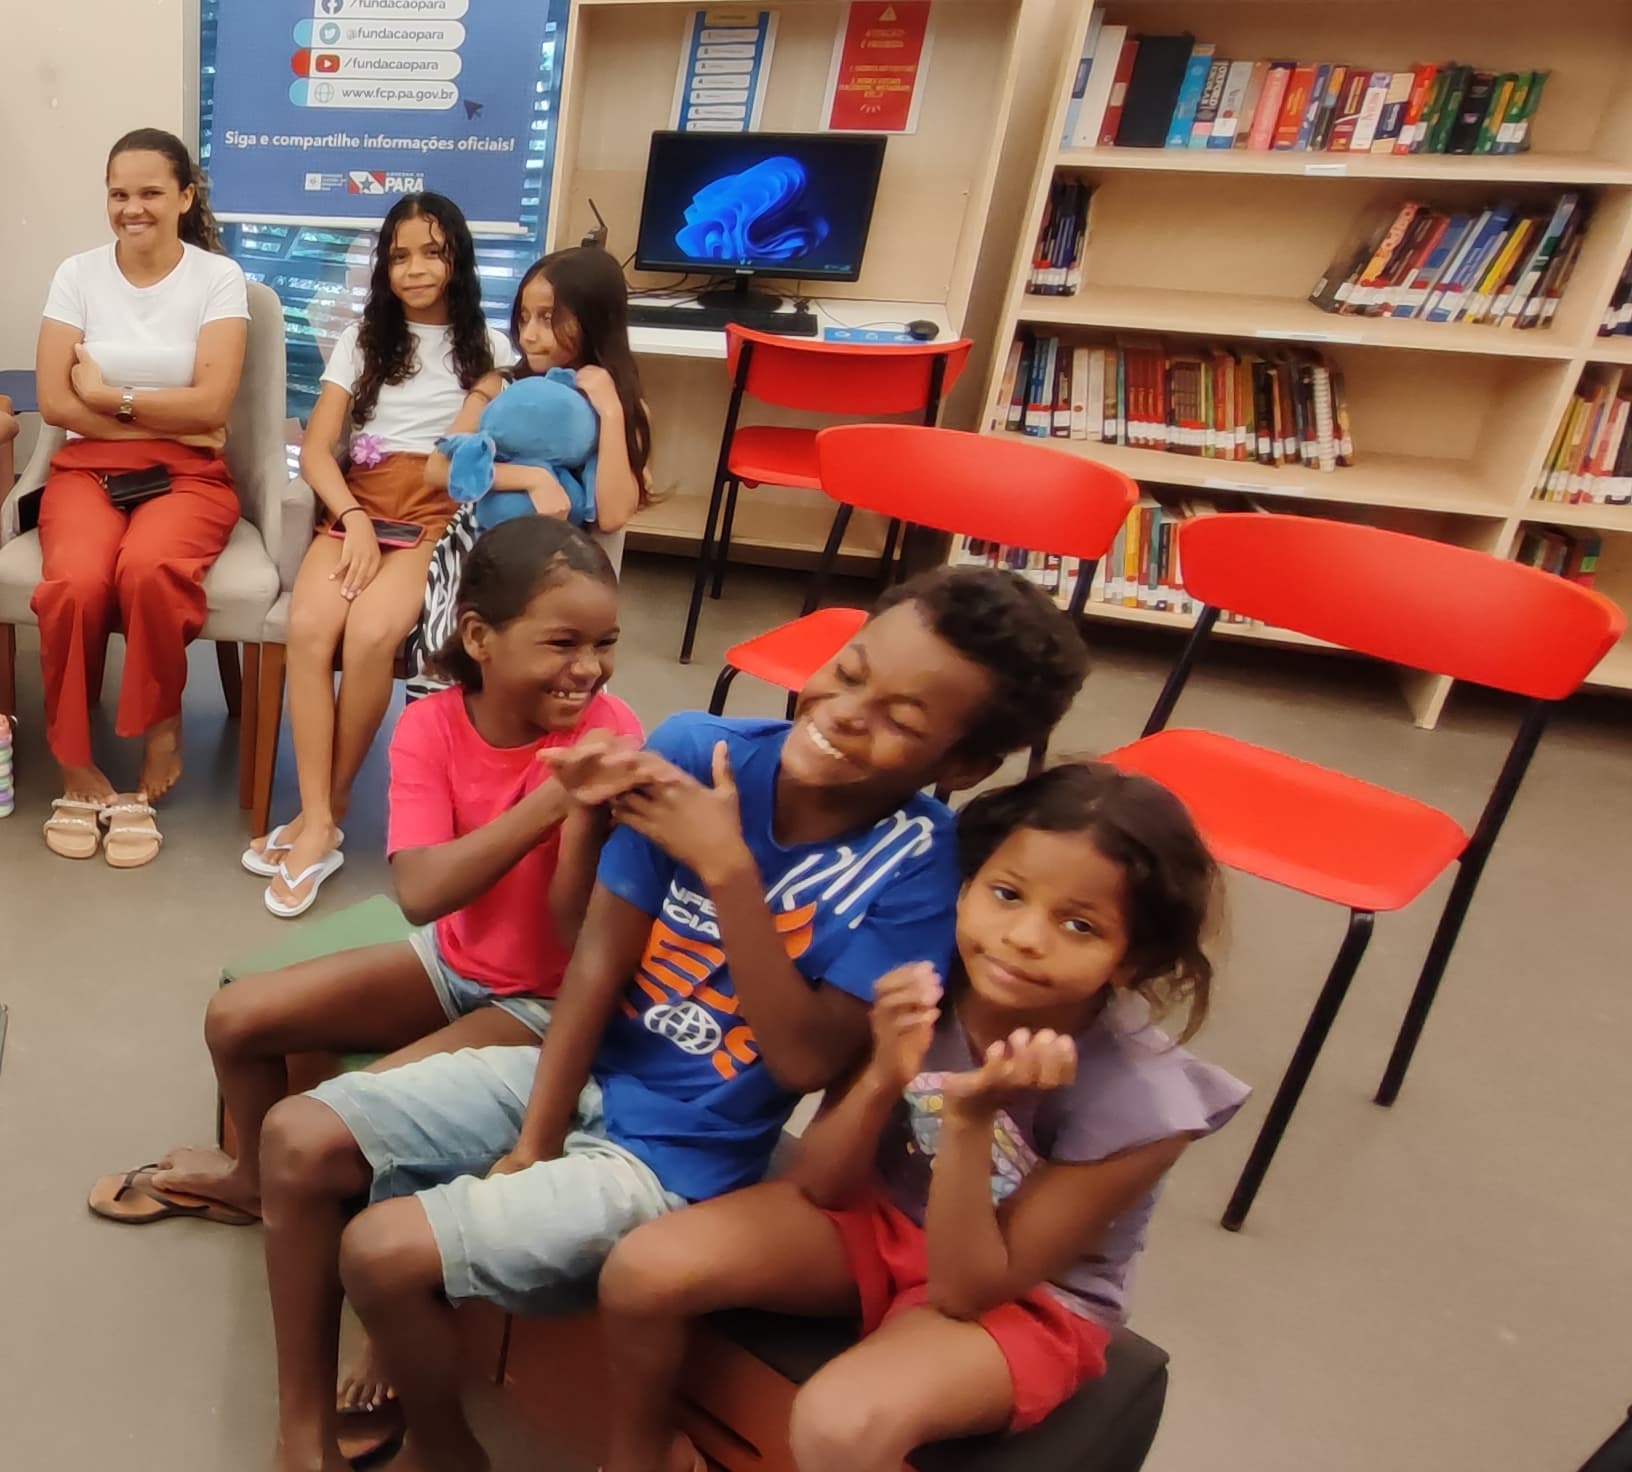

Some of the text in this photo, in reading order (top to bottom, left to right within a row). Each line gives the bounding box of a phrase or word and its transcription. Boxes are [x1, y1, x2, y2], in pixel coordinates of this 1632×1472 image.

[346, 27, 444, 42] @fundacaopara
[344, 58, 439, 72] /fundacaopara
[342, 87, 455, 102] www.fcp.pa.gov.br
[225, 131, 515, 152] Siga e compartilhe informações oficiais!
